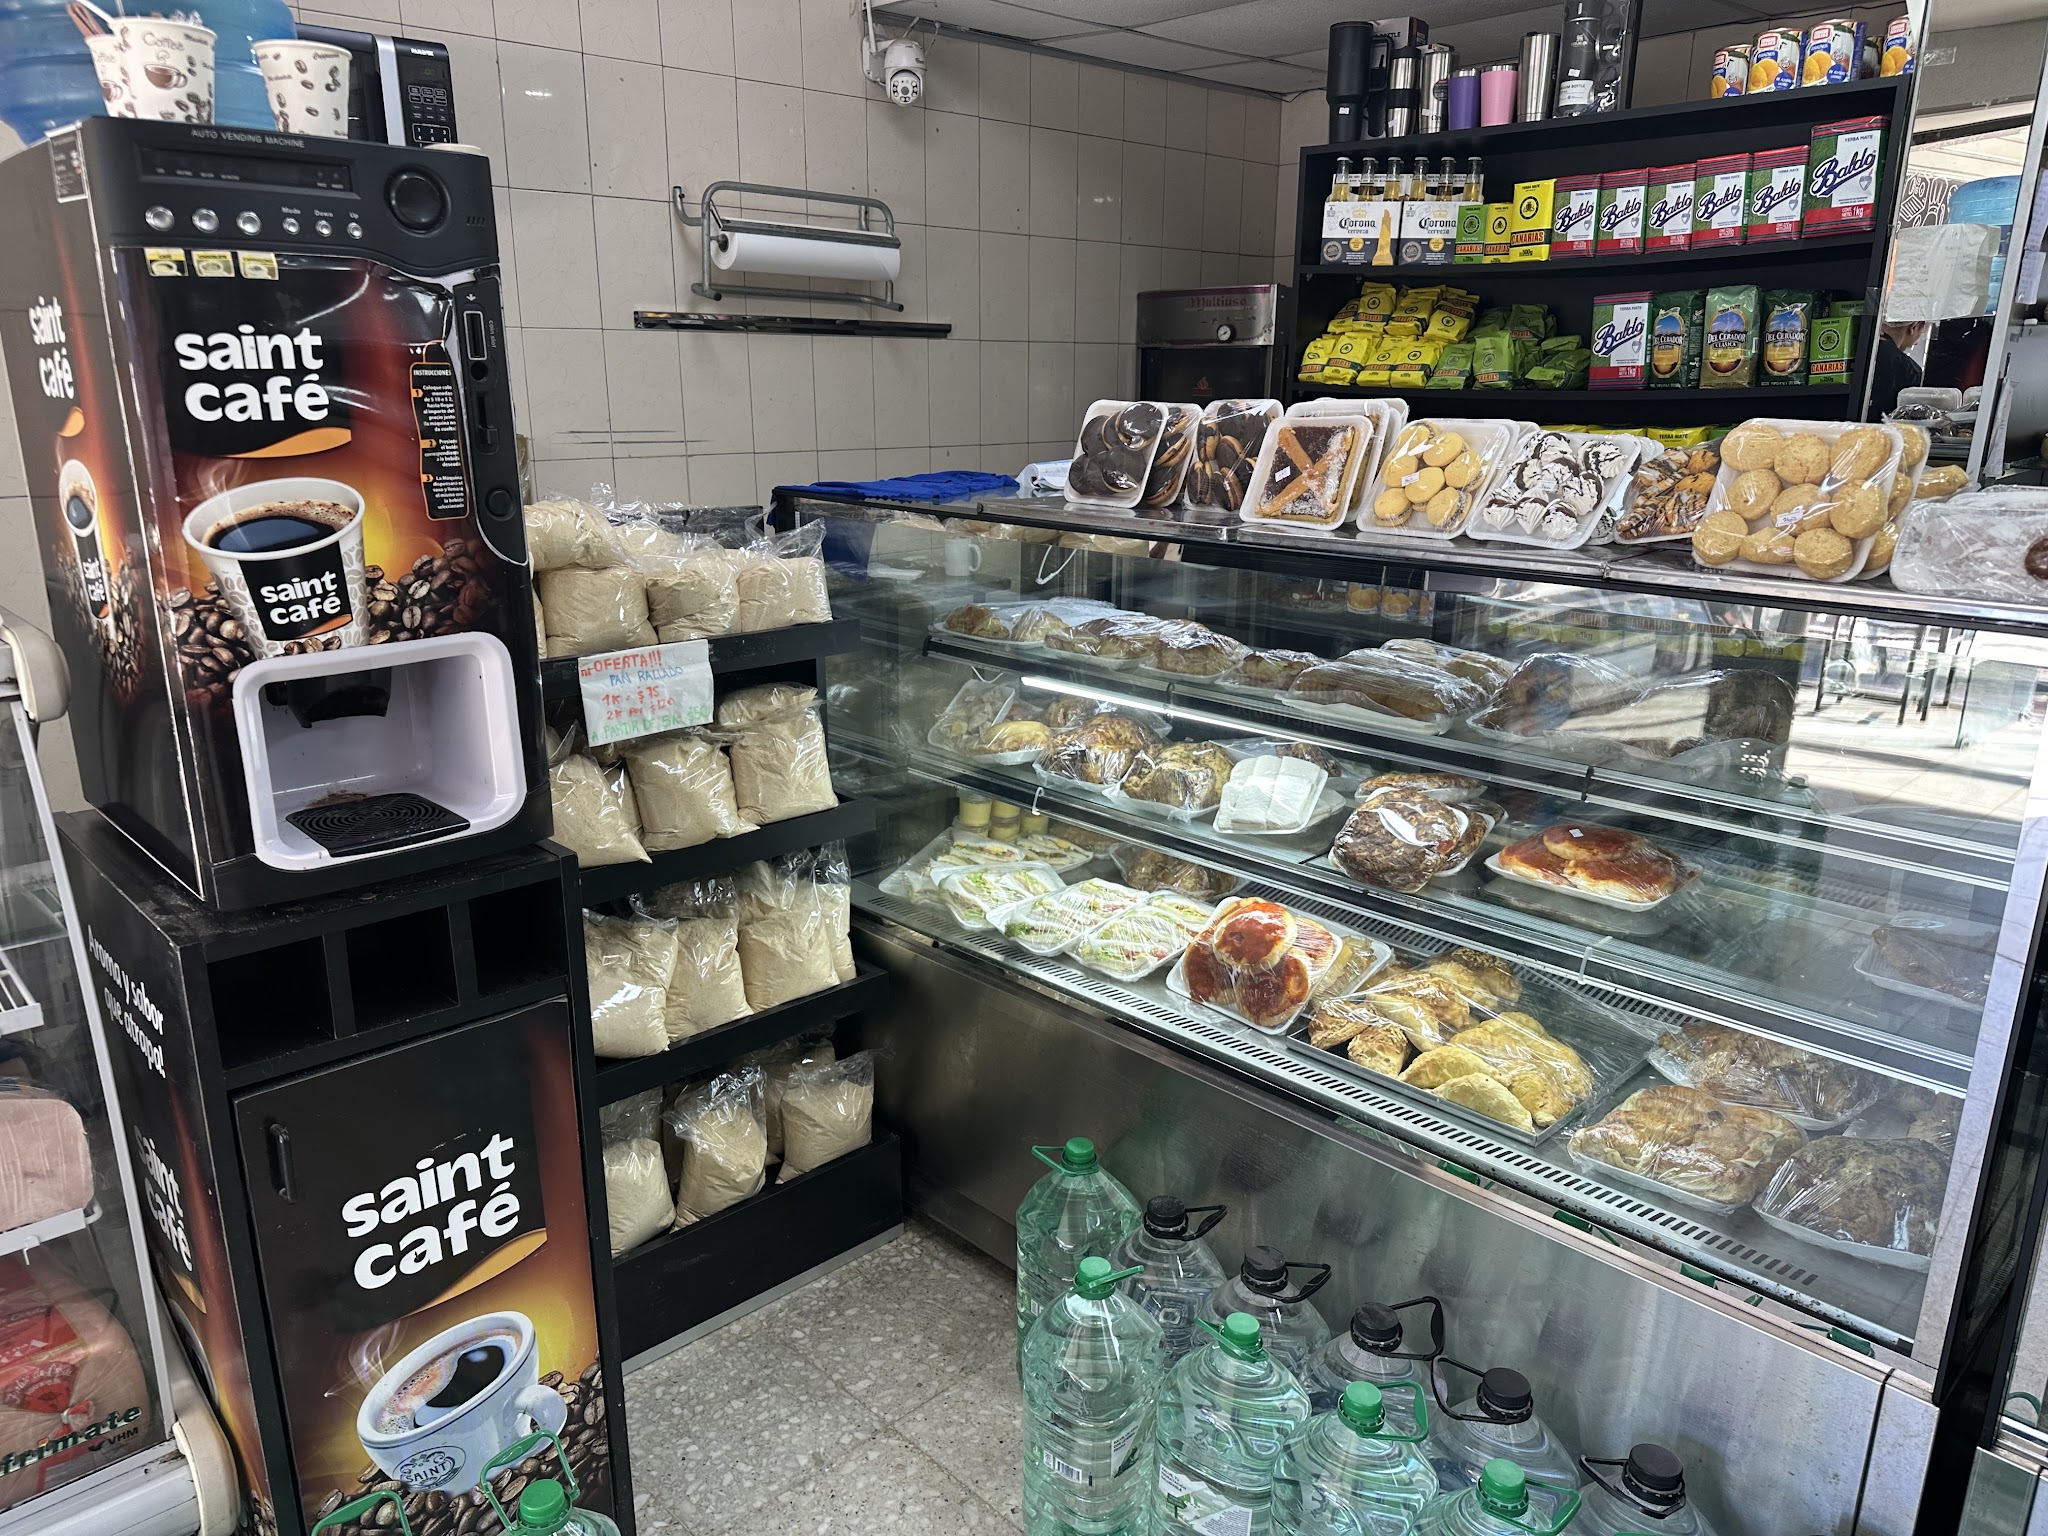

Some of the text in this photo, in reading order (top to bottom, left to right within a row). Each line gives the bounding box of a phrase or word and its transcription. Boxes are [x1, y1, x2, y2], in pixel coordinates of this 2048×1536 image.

[143, 32, 185, 52] Coffee
[191, 129, 305, 148] AUTO VENDING MACHINE
[1811, 147, 1877, 197] Baldo
[1696, 184, 1742, 220] Baldo
[1753, 178, 1801, 215] Baldo
[281, 206, 301, 214] Mode
[314, 209, 334, 217] Down
[1554, 201, 1594, 232] Baldo
[1600, 197, 1641, 231] Baldo
[1650, 193, 1692, 227] Baldo
[1852, 207, 1864, 217] 1kg
[1339, 217, 1377, 230] Corona
[1418, 217, 1457, 230] Corona
[1457, 244, 1482, 253] CANARIAS
[1512, 231, 1544, 244] CANARIAS
[29, 296, 66, 345] saint
[174, 324, 324, 371] saint
[1593, 317, 1645, 356] Baldo
[1707, 333, 1719, 343] DEL
[1766, 333, 1776, 343] DEL
[39, 346, 75, 399] café
[1627, 367, 1637, 377] 1kg
[1811, 363, 1845, 373] CANARIAS
[184, 373, 330, 422] café
[82, 556, 101, 580] saint
[88, 577, 105, 602] café
[260, 570, 338, 604] saint
[269, 594, 342, 625] café
[1566, 611, 1609, 627] CANARIAS
[1626, 616, 1673, 631] CANARIAS
[609, 666, 684, 687] PAN RALLADO
[591, 730, 599, 742] A
[603, 720, 639, 738] PARTIR
[642, 718, 655, 730] DE
[88, 924, 164, 1035] Aroma y sabor
[104, 987, 124, 1026] que
[133, 1124, 184, 1218] saint
[341, 1133, 516, 1238] saint
[144, 1177, 193, 1272] café
[353, 1181, 521, 1290] café
[107, 1426, 139, 1446] VHM
[405, 1461, 447, 1483] SAINT
